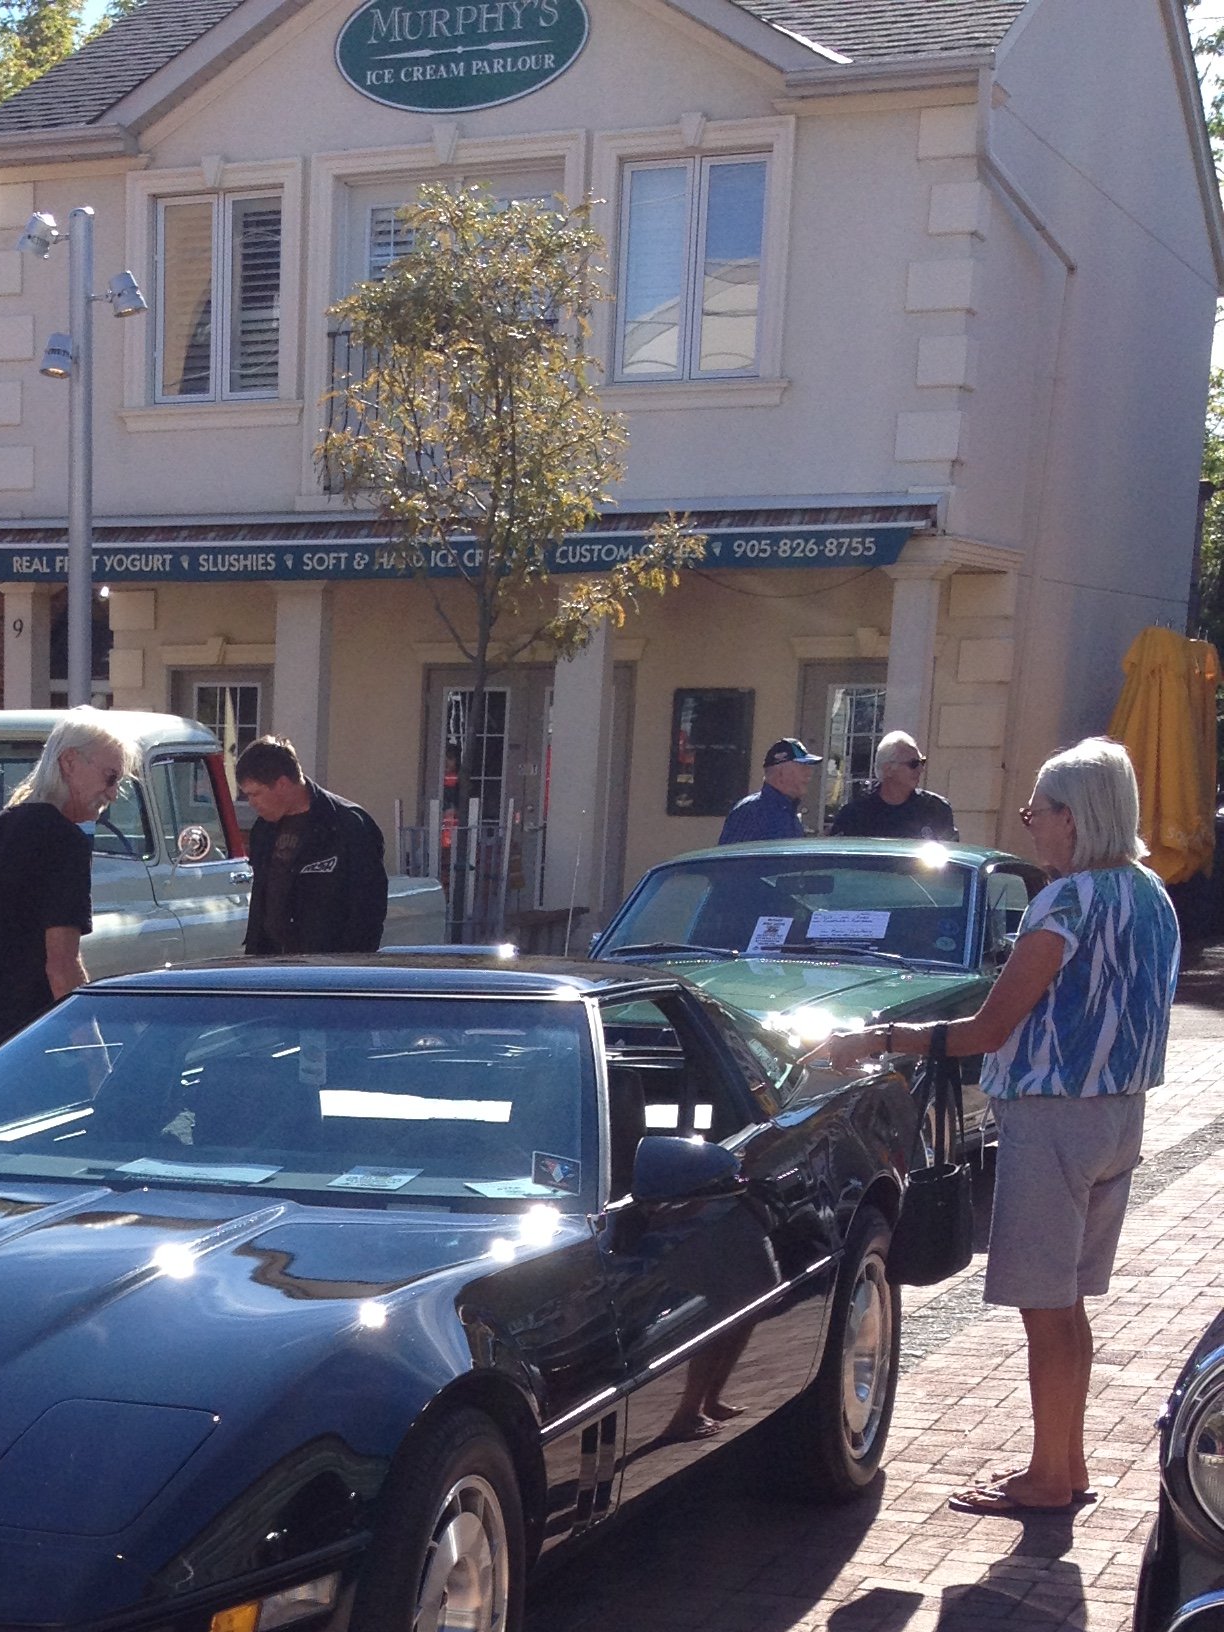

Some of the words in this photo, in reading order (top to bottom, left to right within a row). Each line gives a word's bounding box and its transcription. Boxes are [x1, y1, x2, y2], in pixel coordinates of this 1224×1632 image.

[367, 0, 559, 44] MURPHY'S
[366, 69, 394, 85] ICE
[400, 61, 465, 82] CREAM
[471, 54, 556, 76] PARLOUR
[12, 556, 51, 573] REAL
[103, 554, 173, 572] YOGURT
[198, 553, 277, 572] SLUSHIES
[302, 552, 349, 571] SOFT
[353, 552, 370, 570] &
[430, 549, 459, 568] ICE
[555, 543, 634, 564] CUSTOM
[12, 618, 24, 638] 9
